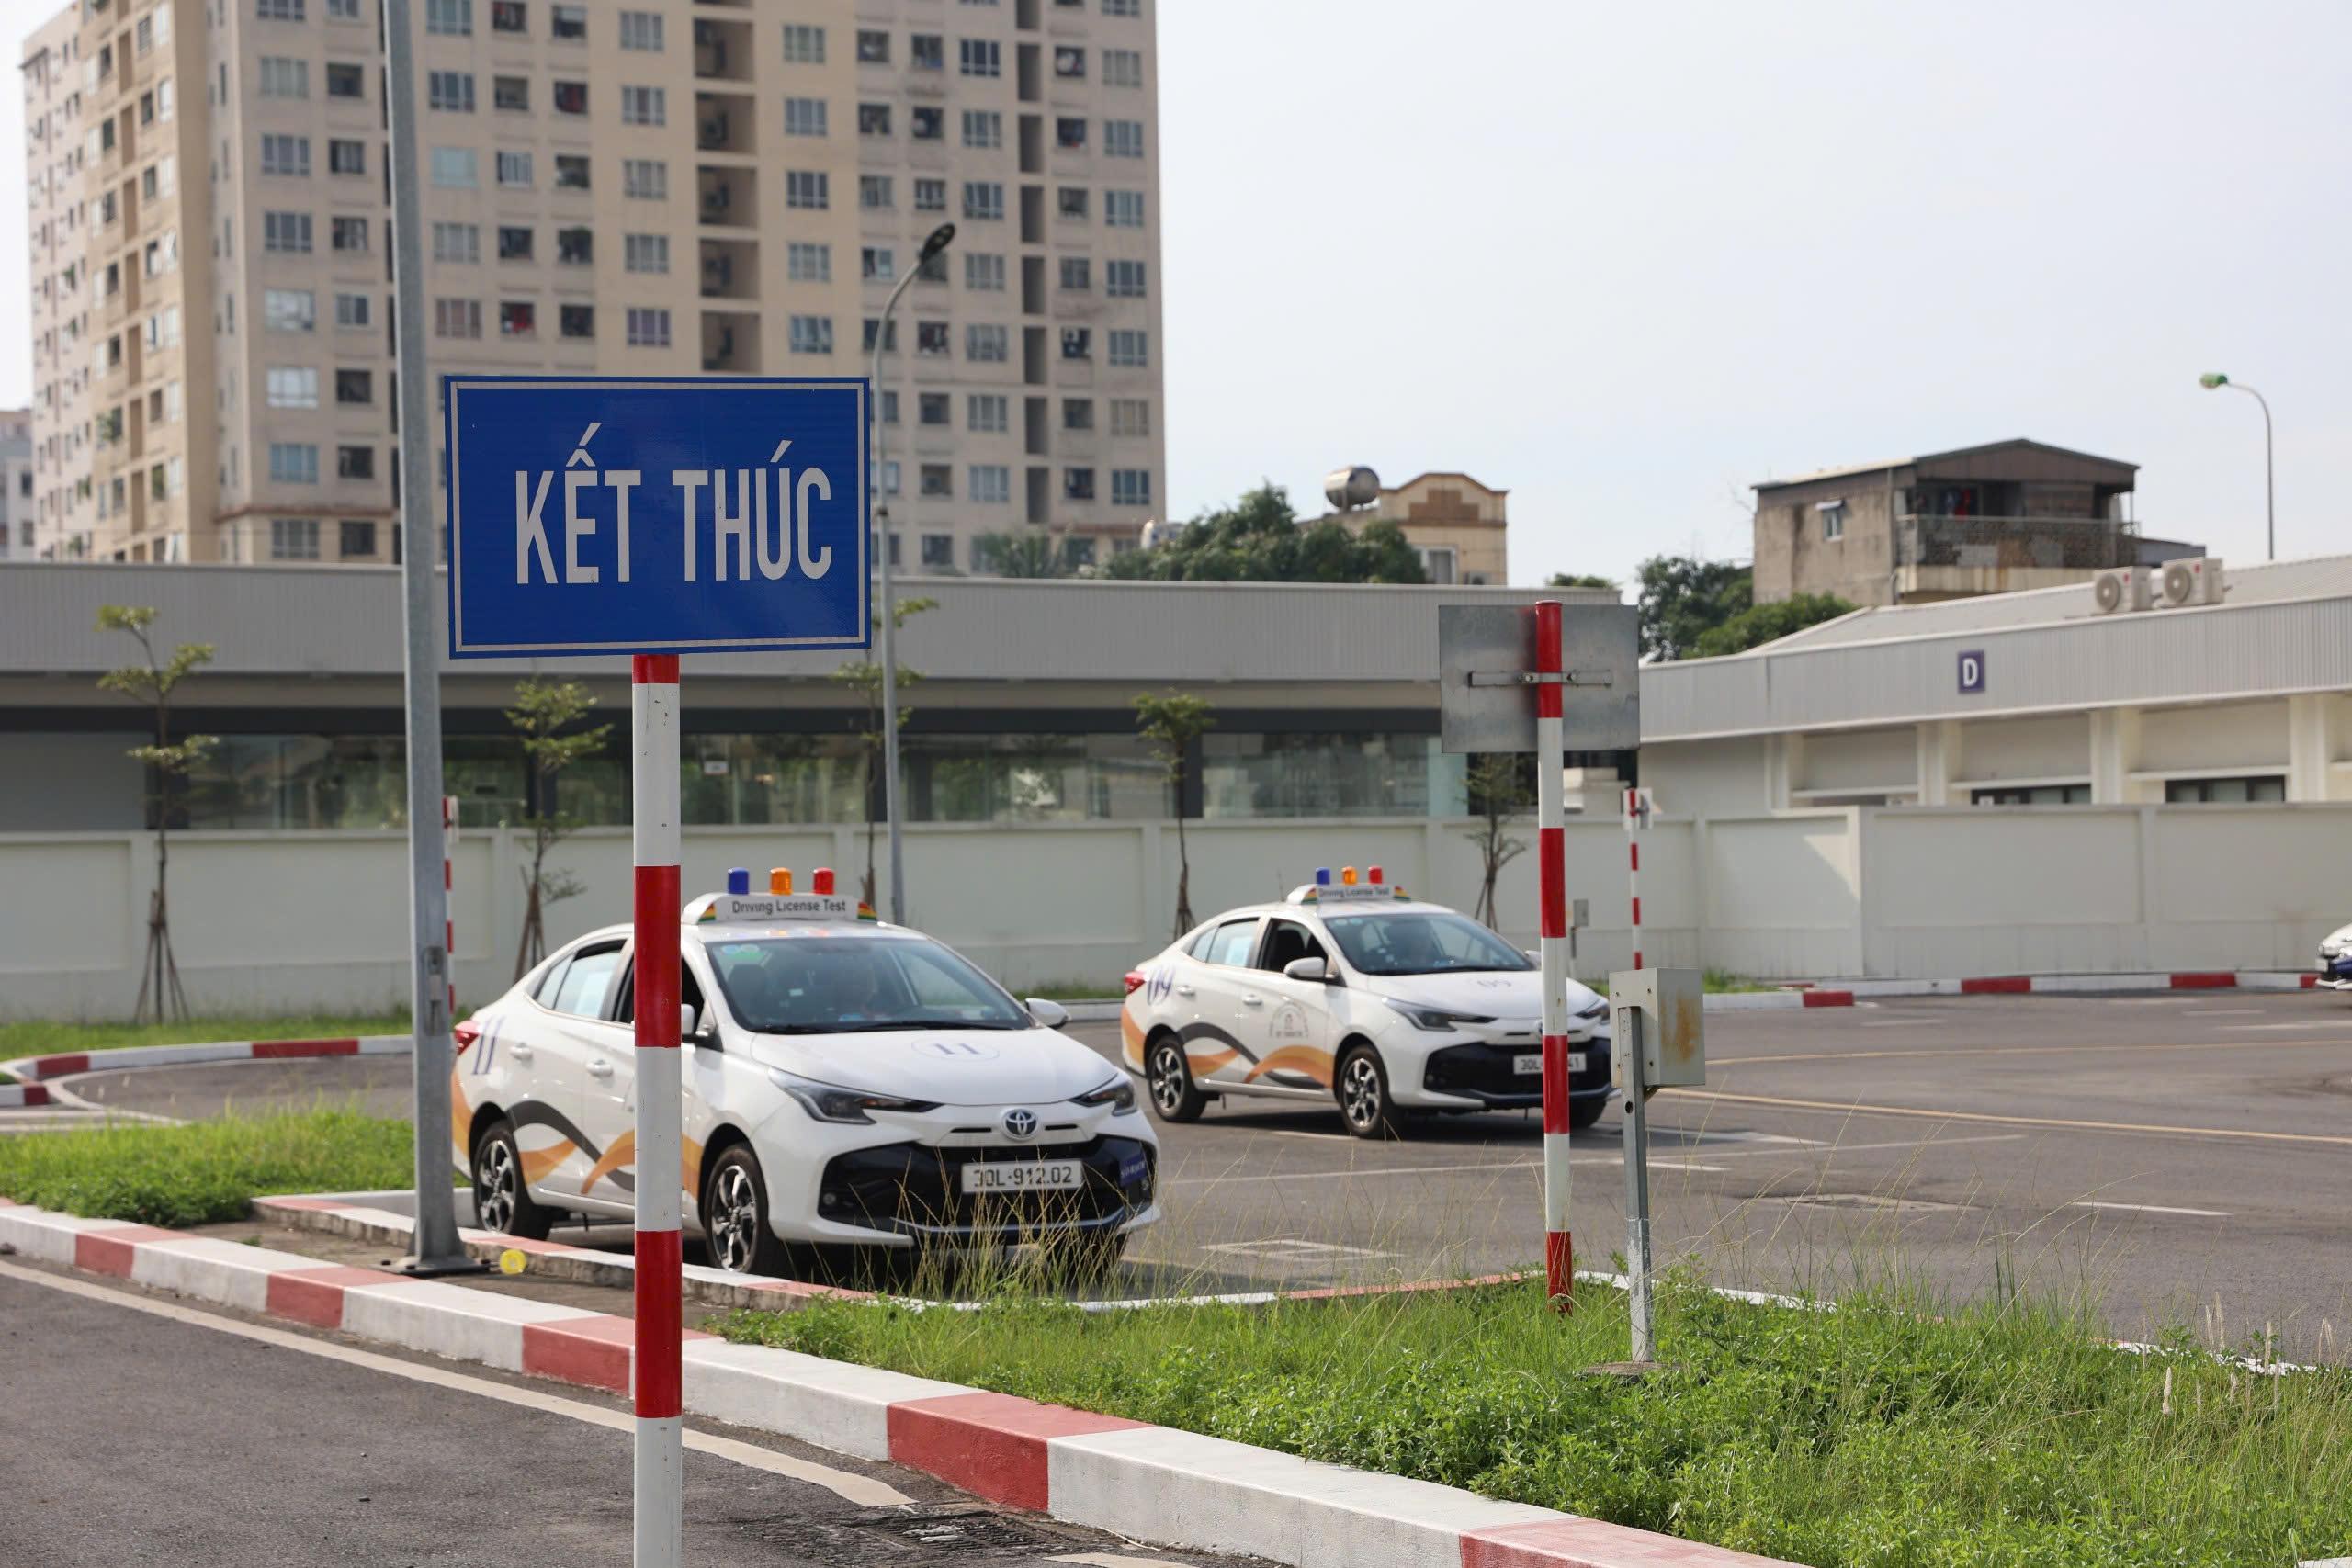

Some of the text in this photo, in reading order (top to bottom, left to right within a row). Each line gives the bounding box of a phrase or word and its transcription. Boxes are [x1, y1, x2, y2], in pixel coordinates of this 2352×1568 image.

[515, 423, 832, 584] KẾT THÚC
[1962, 658, 1978, 687] D
[732, 898, 846, 914] Driving License Test
[471, 1014, 505, 1075] 11
[933, 1043, 980, 1055] 11
